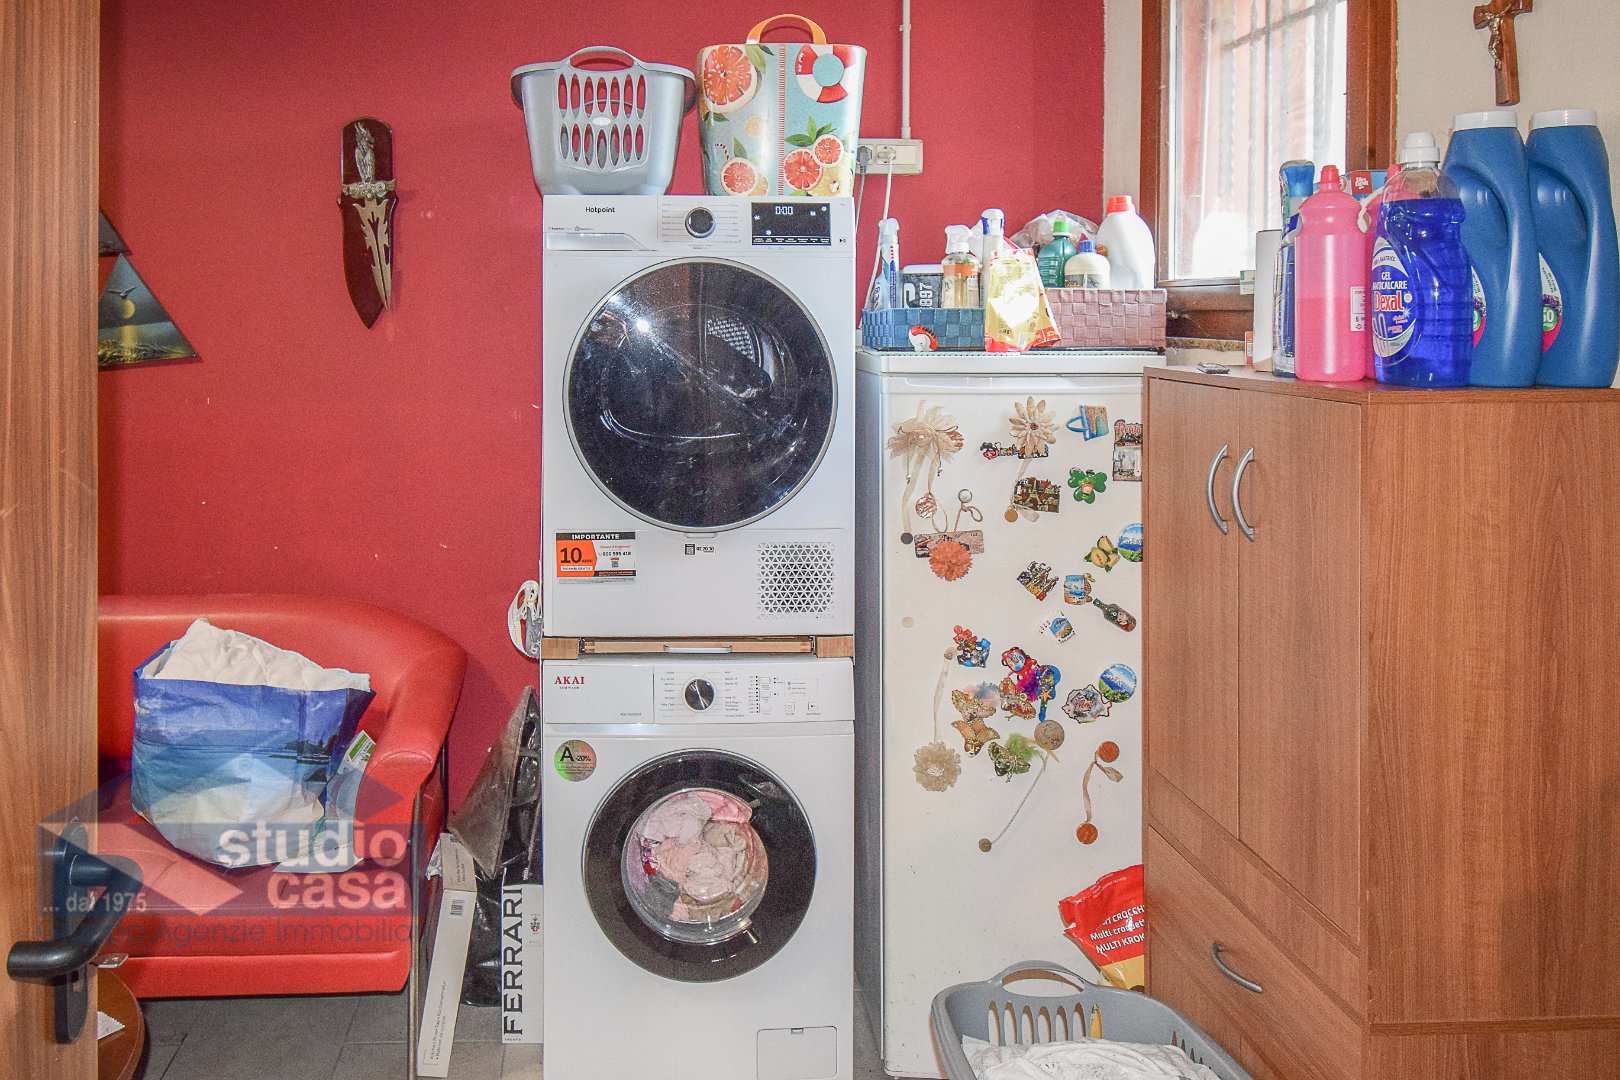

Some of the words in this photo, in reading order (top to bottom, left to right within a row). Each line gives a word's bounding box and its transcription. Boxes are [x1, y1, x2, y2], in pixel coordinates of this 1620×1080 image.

[585, 206, 616, 214] Hotpoint
[1381, 271, 1391, 280] GEL
[1372, 280, 1408, 290] ANTICALCARE
[919, 282, 933, 309] 897
[1374, 290, 1404, 312] Dexal
[560, 547, 583, 564] 10
[554, 676, 585, 685] AKAI
[560, 746, 575, 762] A
[1090, 928, 1112, 941] Multi
[1096, 939, 1122, 954] MULTI
[503, 888, 523, 1035] FERRARI
